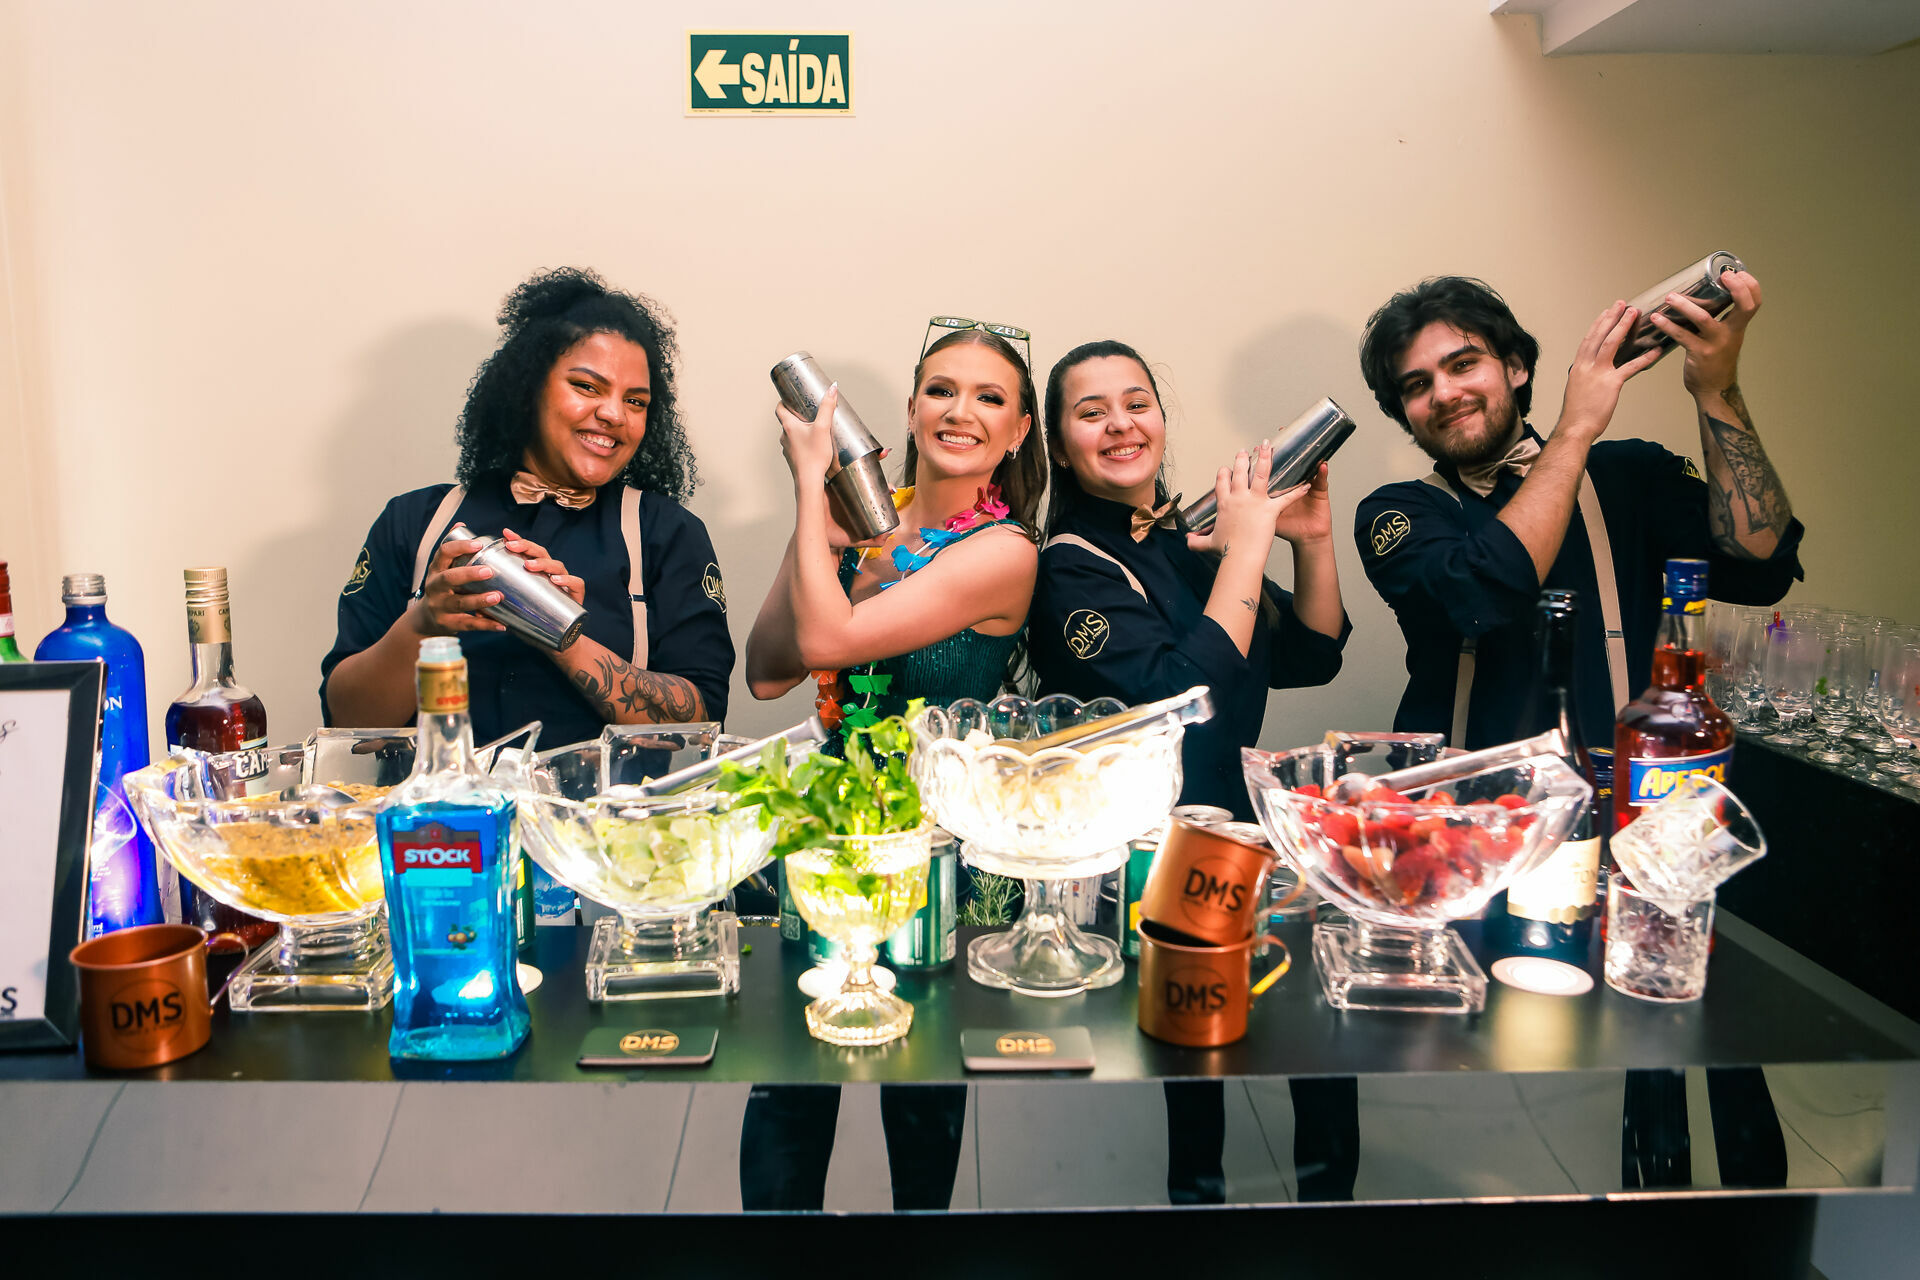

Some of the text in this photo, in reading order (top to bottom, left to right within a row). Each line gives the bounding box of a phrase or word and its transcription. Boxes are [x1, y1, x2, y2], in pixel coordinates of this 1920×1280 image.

[741, 38, 846, 105] SAÍDA
[1374, 515, 1406, 551] DMS
[1071, 614, 1104, 654] DMS
[404, 848, 471, 866] STOCK
[1184, 867, 1247, 911] DMS
[111, 991, 182, 1031] DMS
[1165, 980, 1227, 1011] DMS
[623, 1034, 676, 1050] DMS
[999, 1038, 1051, 1053] DMS
